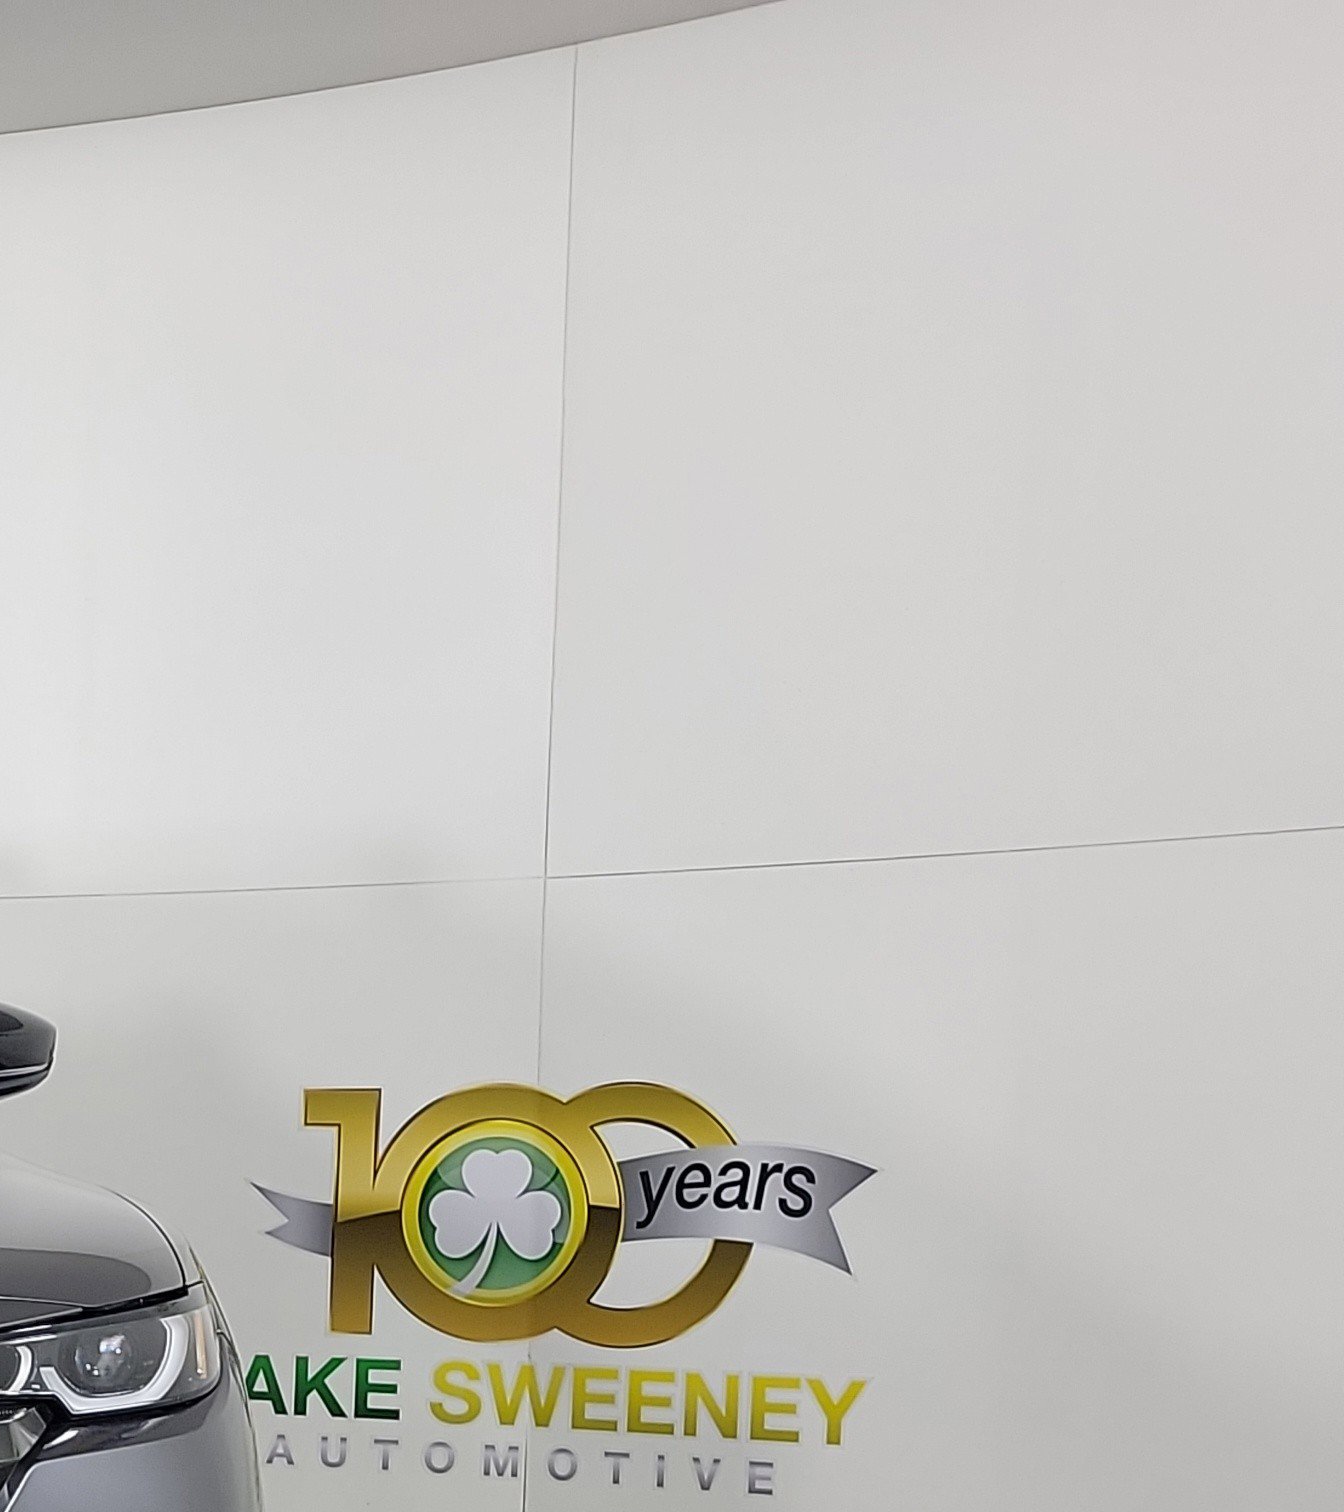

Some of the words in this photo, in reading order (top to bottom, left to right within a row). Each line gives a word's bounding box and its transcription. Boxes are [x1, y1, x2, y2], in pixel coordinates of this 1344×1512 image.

[303, 1081, 753, 1348] 100
[635, 1160, 816, 1229] years
[245, 1355, 402, 1421] AKE
[429, 1360, 865, 1446] SWEENEY
[266, 1434, 773, 1495] AUTOMOTIVE
